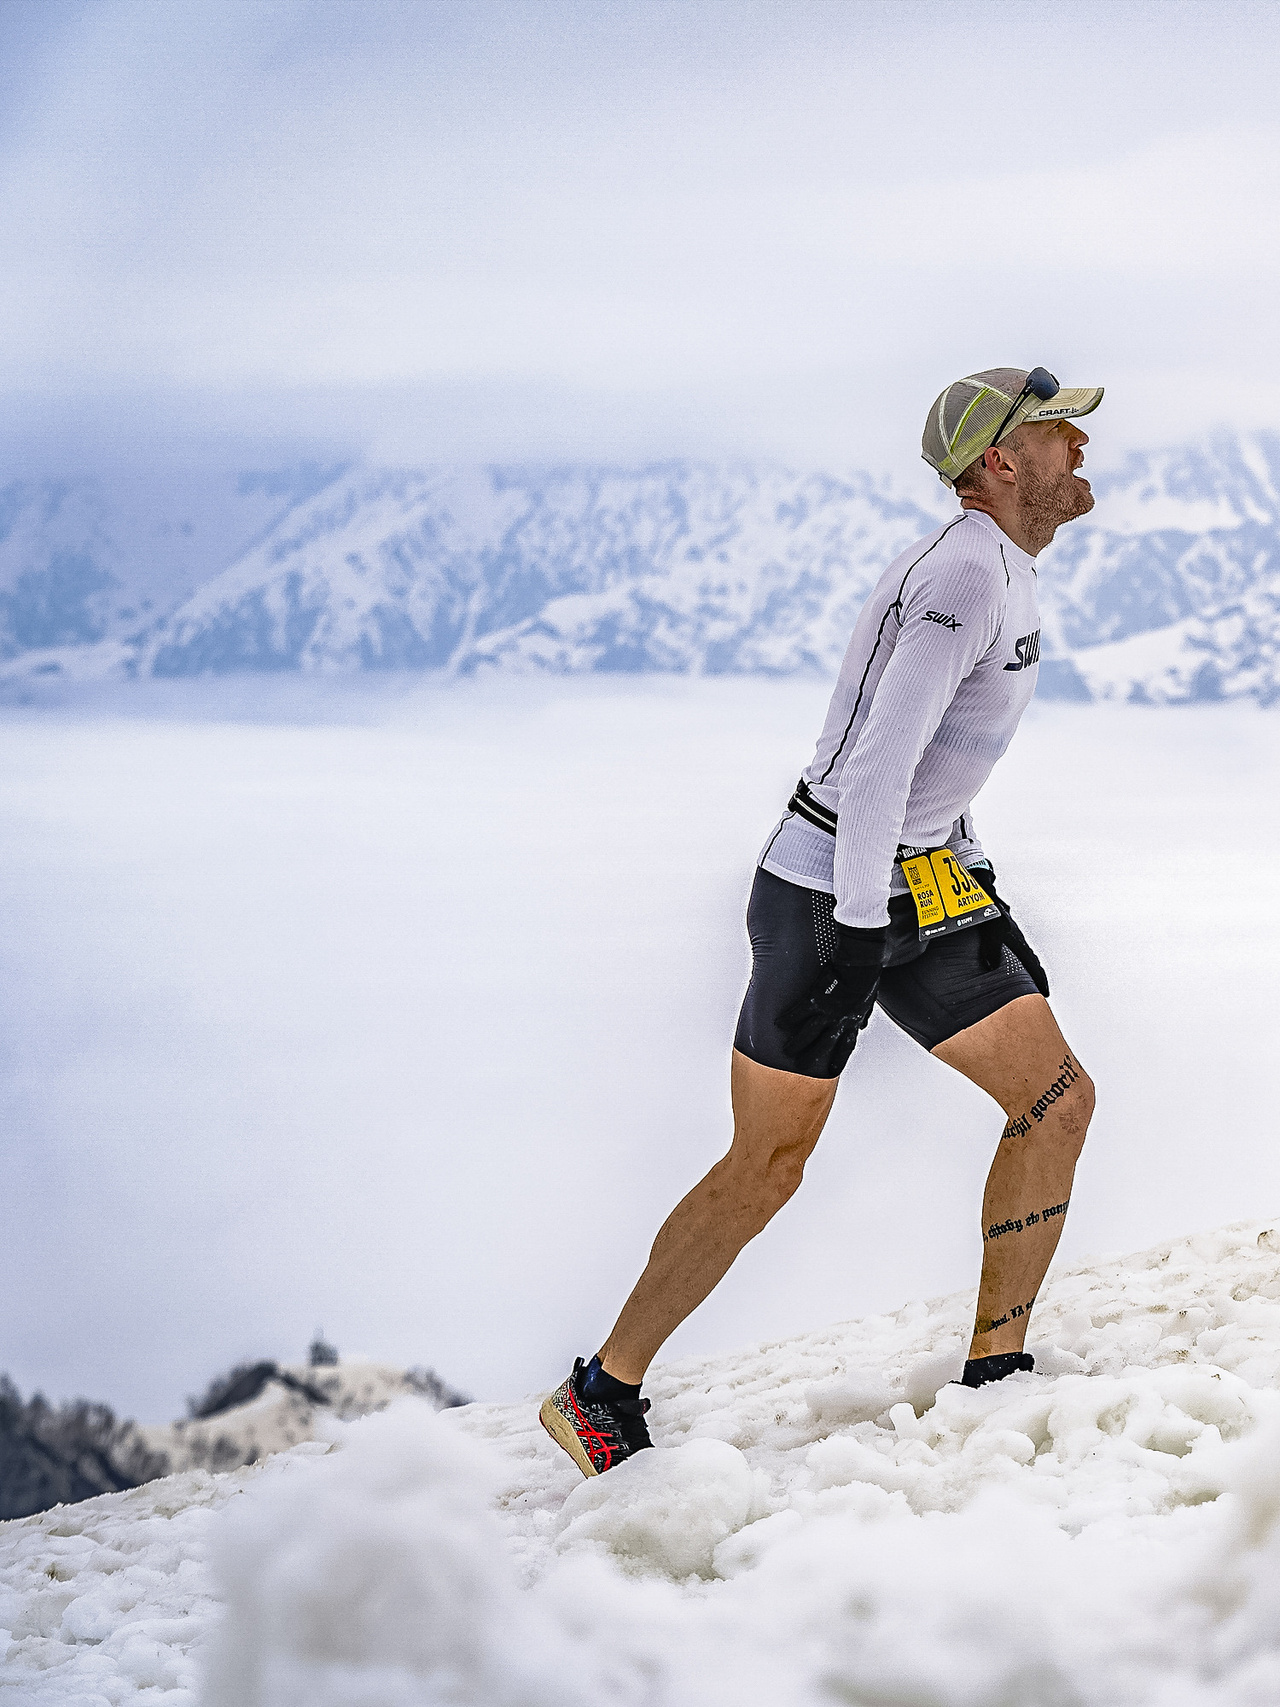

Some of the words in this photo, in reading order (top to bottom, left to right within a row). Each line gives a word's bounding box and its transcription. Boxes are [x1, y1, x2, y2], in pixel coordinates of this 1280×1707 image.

[1039, 407, 1071, 417] CRAFT
[917, 889, 935, 901] ROSA
[958, 891, 986, 908] ARTYOM
[919, 898, 933, 908] RUN
